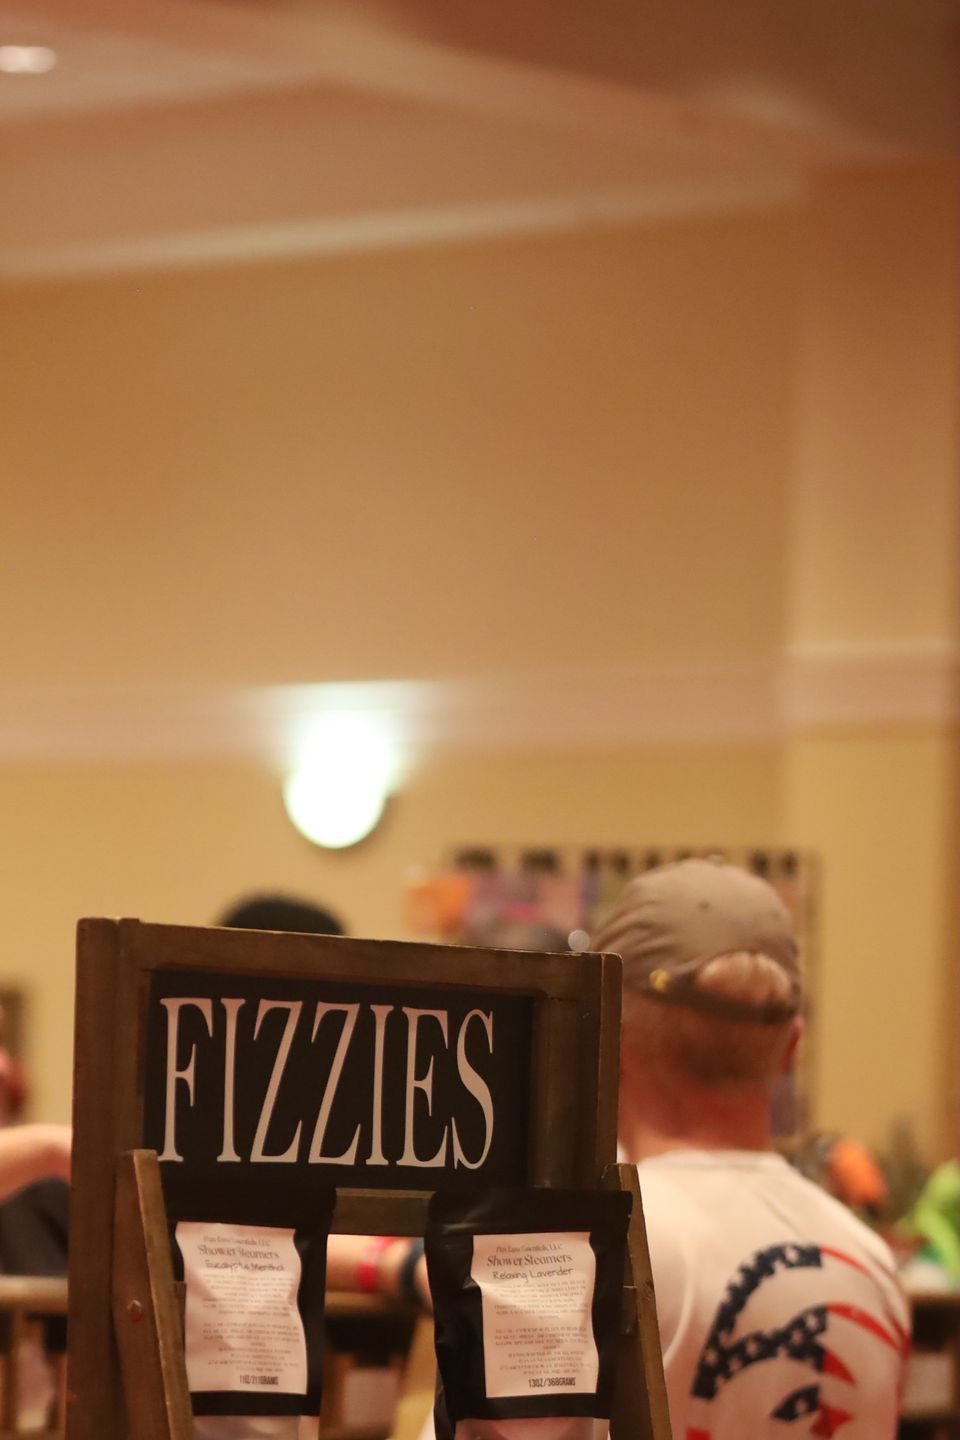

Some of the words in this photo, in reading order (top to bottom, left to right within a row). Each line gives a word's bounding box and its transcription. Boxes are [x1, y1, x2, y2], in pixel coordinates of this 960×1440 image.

[157, 997, 495, 1171] FIZZIES
[198, 1243, 235, 1257] Shower
[236, 1246, 280, 1259] Steamers
[487, 1255, 523, 1267] Shower
[523, 1254, 574, 1266] Steamers
[492, 1271, 529, 1283] Relaxing
[529, 1266, 574, 1278] Lavender
